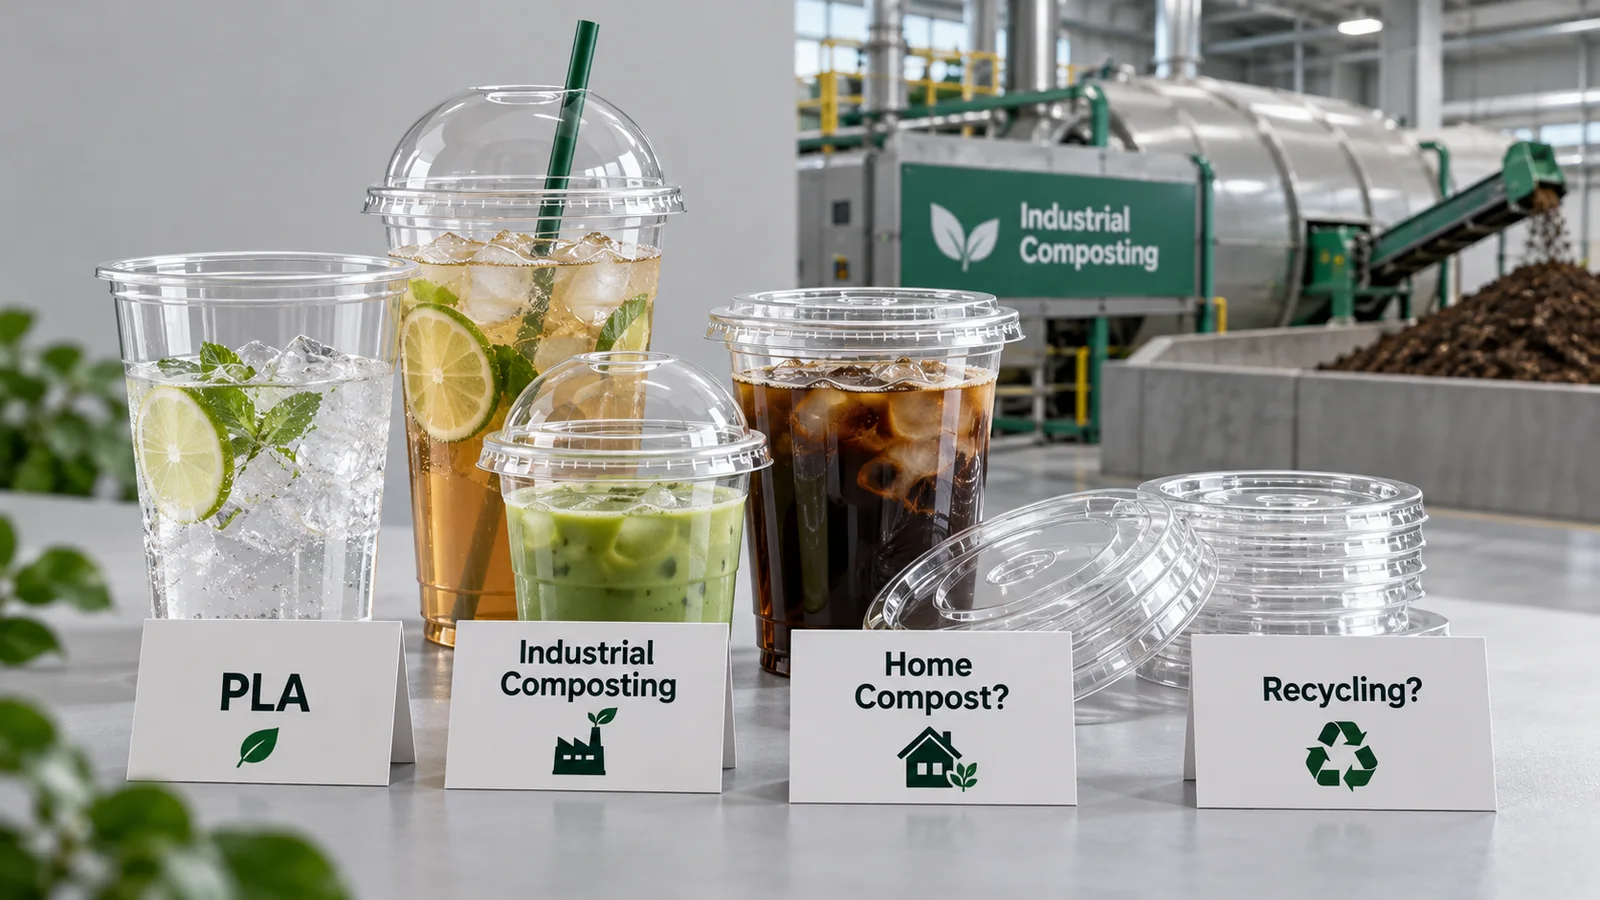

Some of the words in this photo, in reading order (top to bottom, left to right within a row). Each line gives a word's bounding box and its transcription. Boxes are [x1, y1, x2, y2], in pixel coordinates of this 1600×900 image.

[1021, 202, 1130, 232] Industrial
[1020, 236, 1159, 272] Composting
[519, 638, 654, 665] Industrial
[885, 651, 973, 677] Home
[220, 672, 311, 712] PLA
[500, 670, 677, 704] Composting
[854, 683, 1010, 717] Compost?
[1263, 675, 1423, 709] Recycling?
